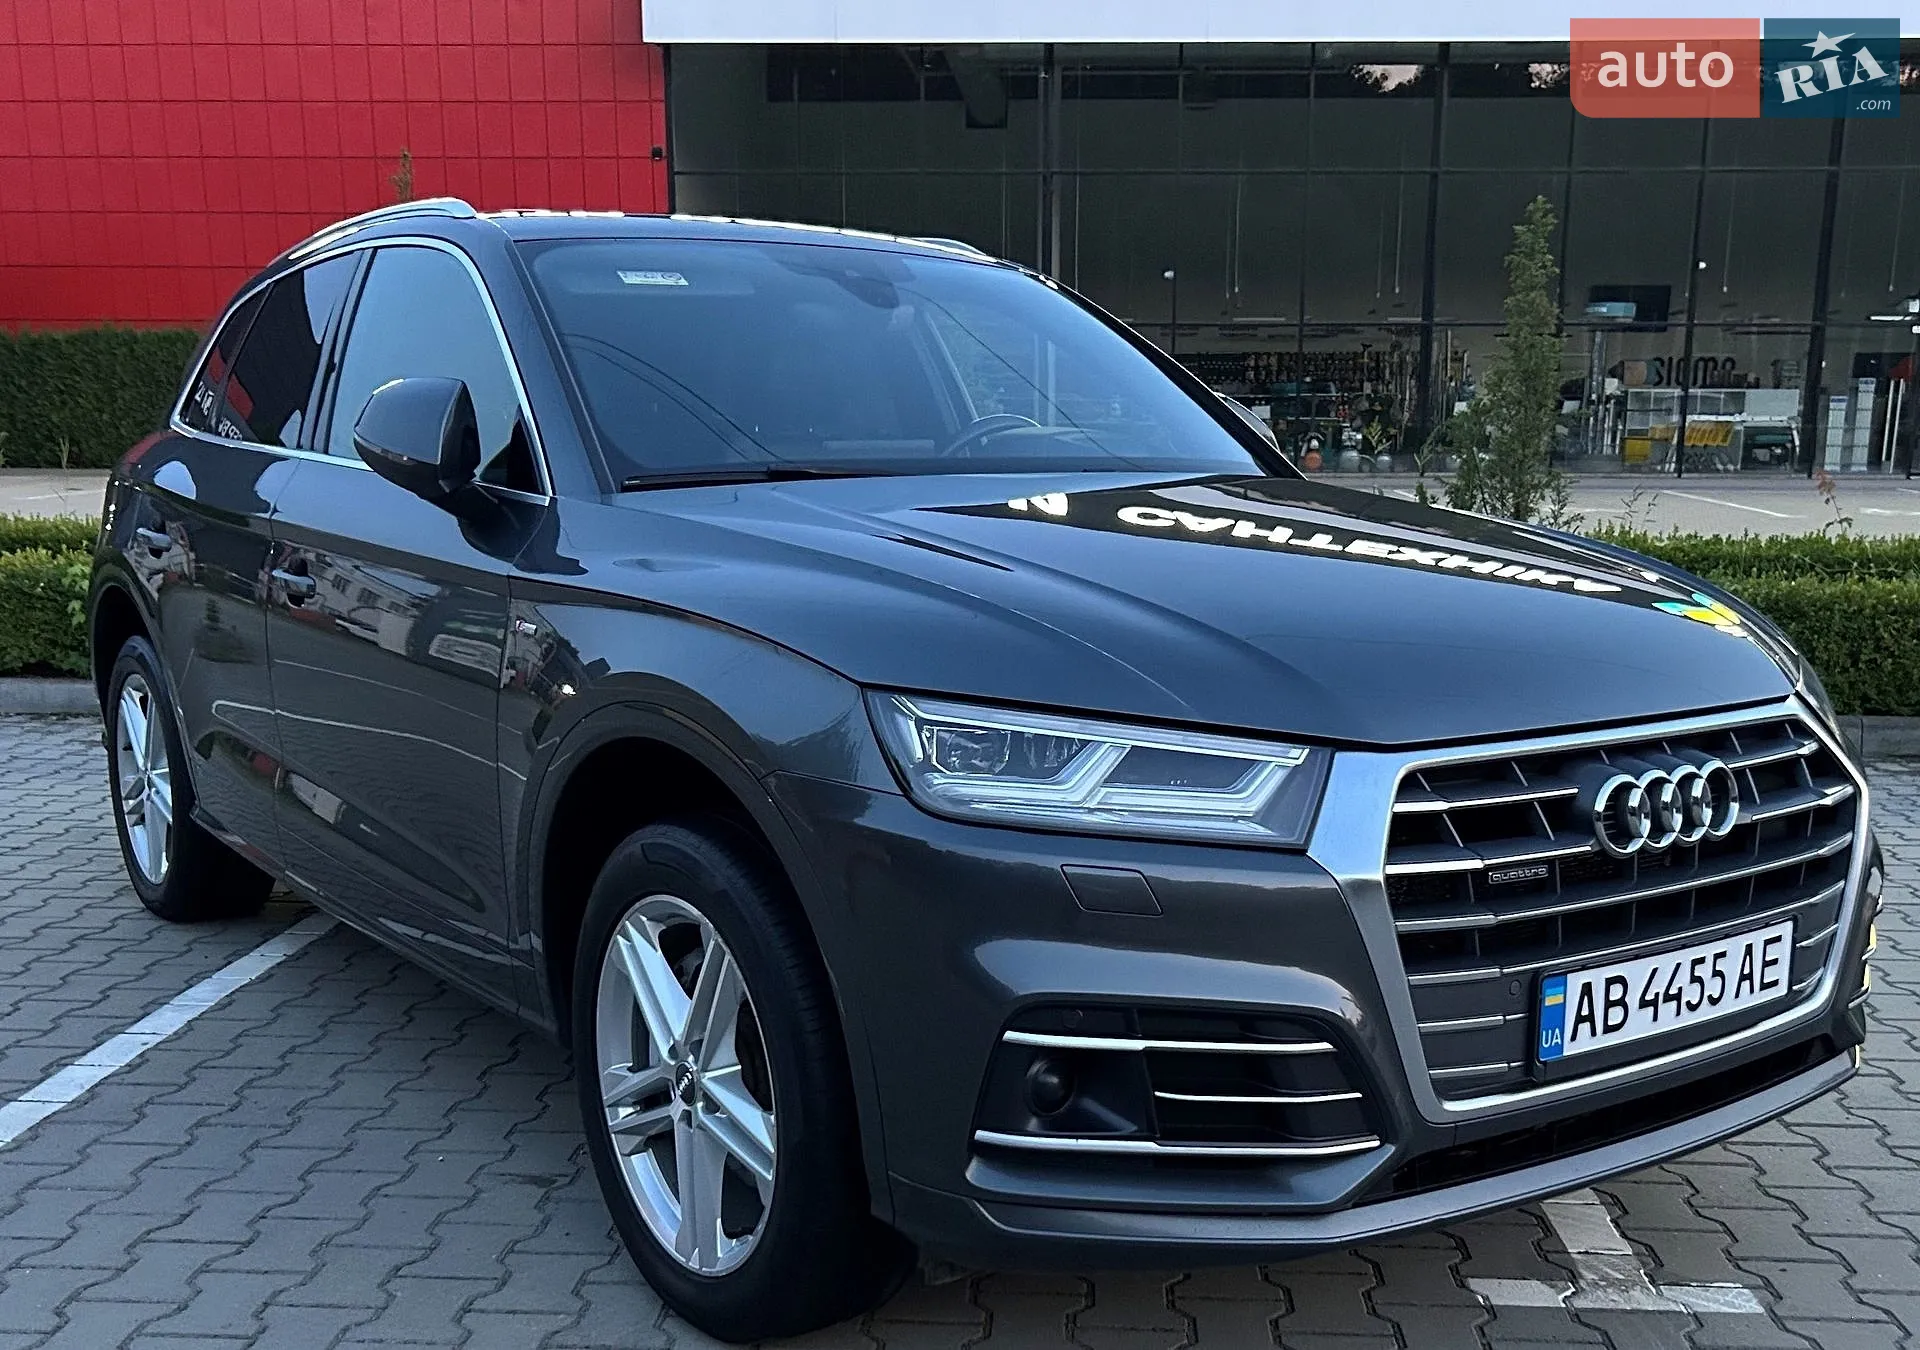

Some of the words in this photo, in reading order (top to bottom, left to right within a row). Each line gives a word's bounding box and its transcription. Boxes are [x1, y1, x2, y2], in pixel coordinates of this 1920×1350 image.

[1492, 867, 1547, 881] quattro
[1570, 974, 1629, 1042] AB
[1638, 950, 1728, 1022] 4455
[1734, 934, 1783, 999] AE
[1541, 1027, 1562, 1048] UA
